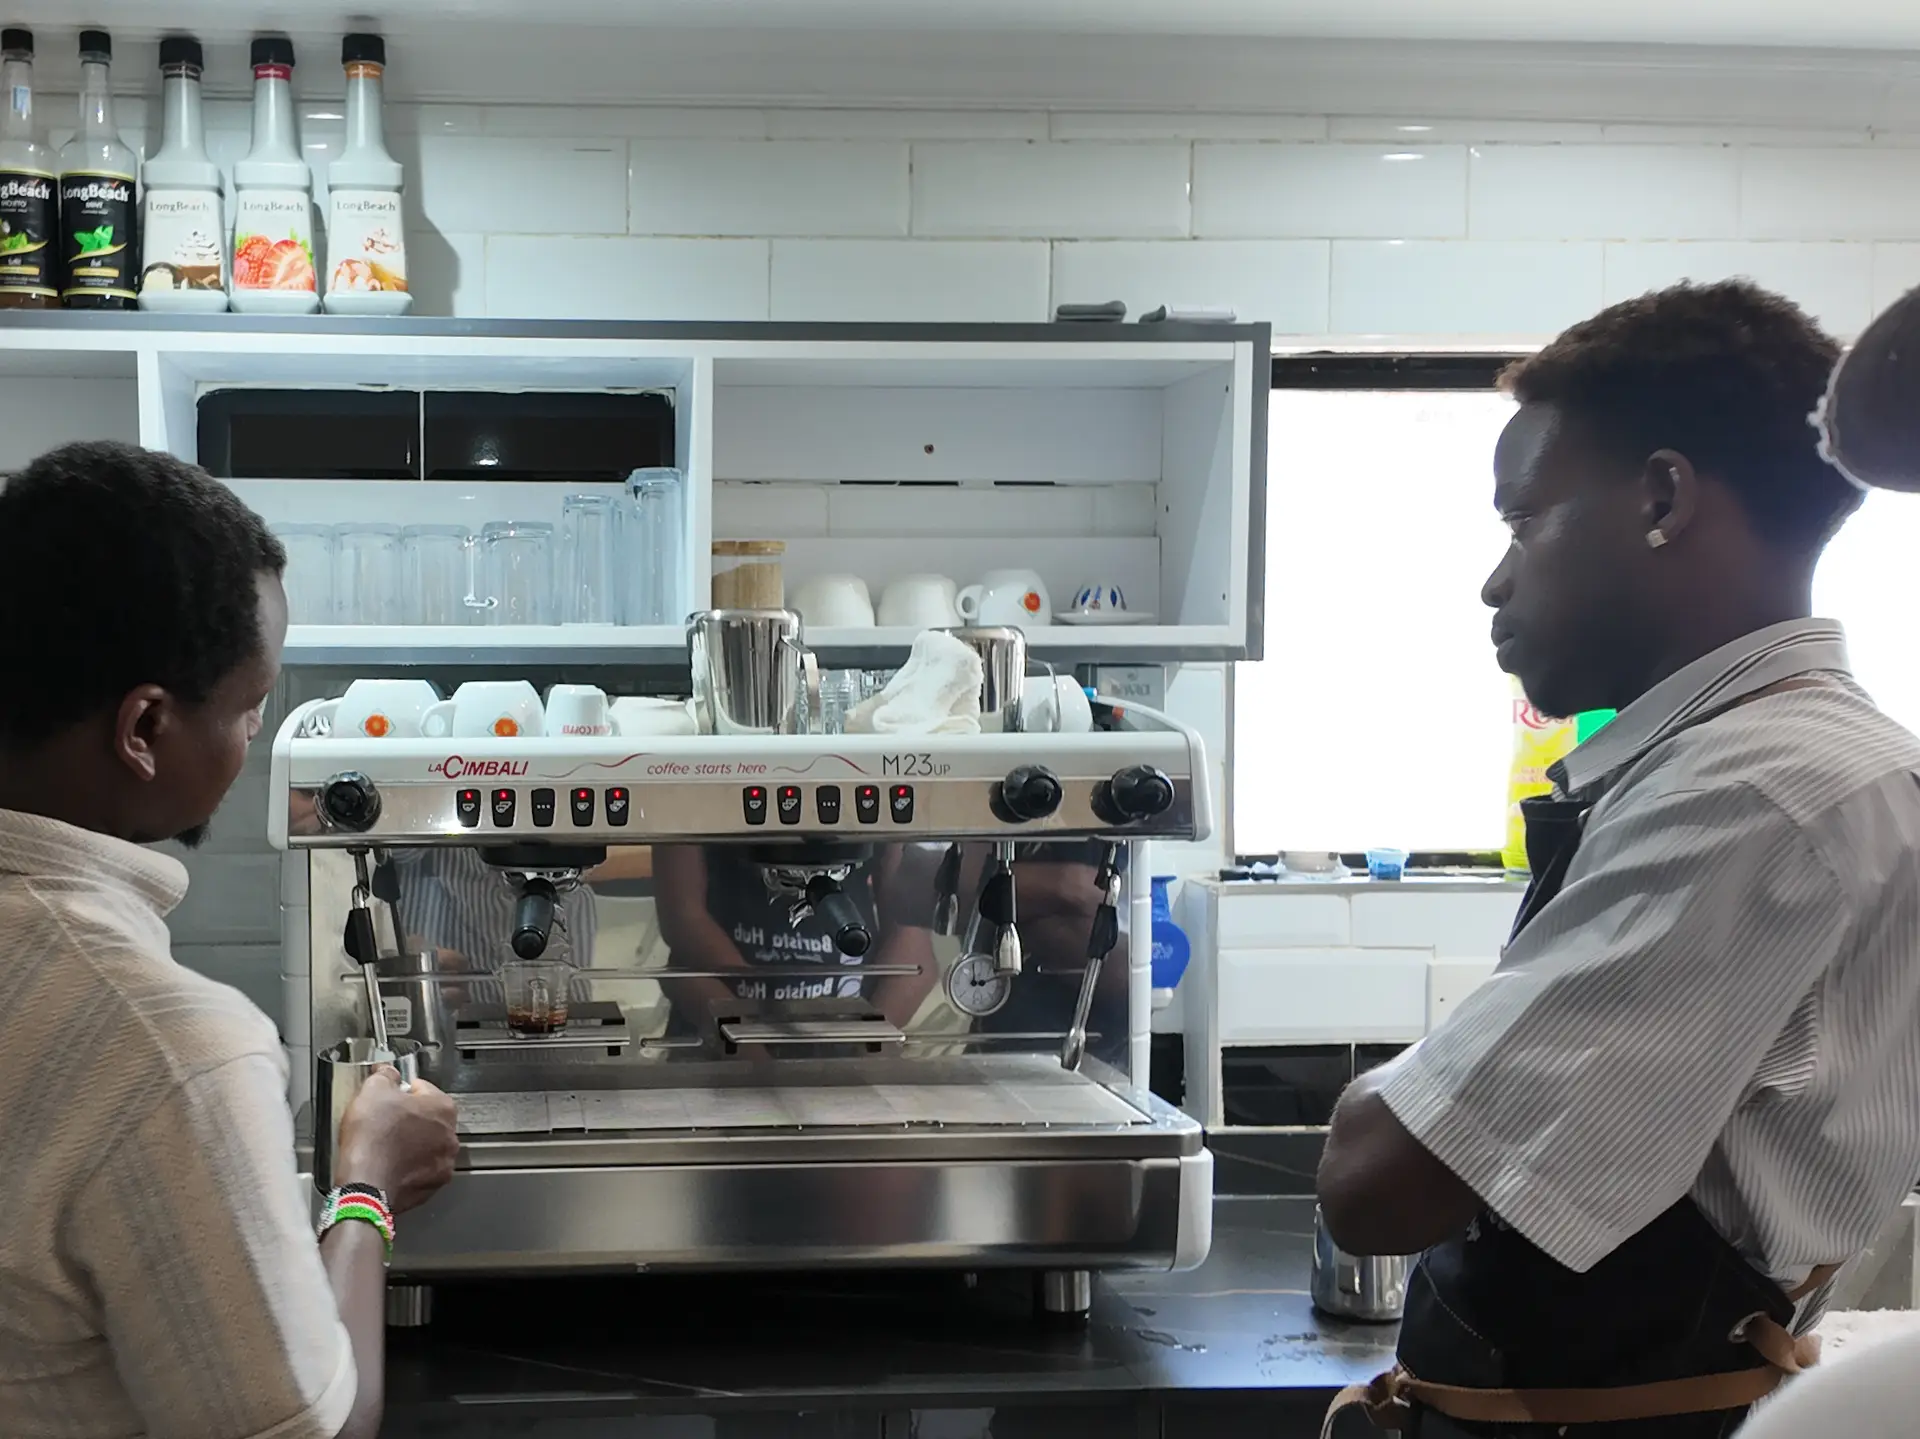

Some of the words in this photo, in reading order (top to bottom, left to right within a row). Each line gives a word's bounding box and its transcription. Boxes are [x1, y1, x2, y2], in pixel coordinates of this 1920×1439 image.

[0, 181, 50, 200] gBeach
[63, 183, 129, 202] LongBeach
[150, 201, 209, 212] LongBeach
[244, 201, 304, 212] LongBeach
[337, 201, 397, 212] LongBeach
[443, 755, 529, 779] CIMBALI
[647, 763, 690, 775] coffee
[695, 764, 732, 775] starts
[737, 762, 767, 774] here
